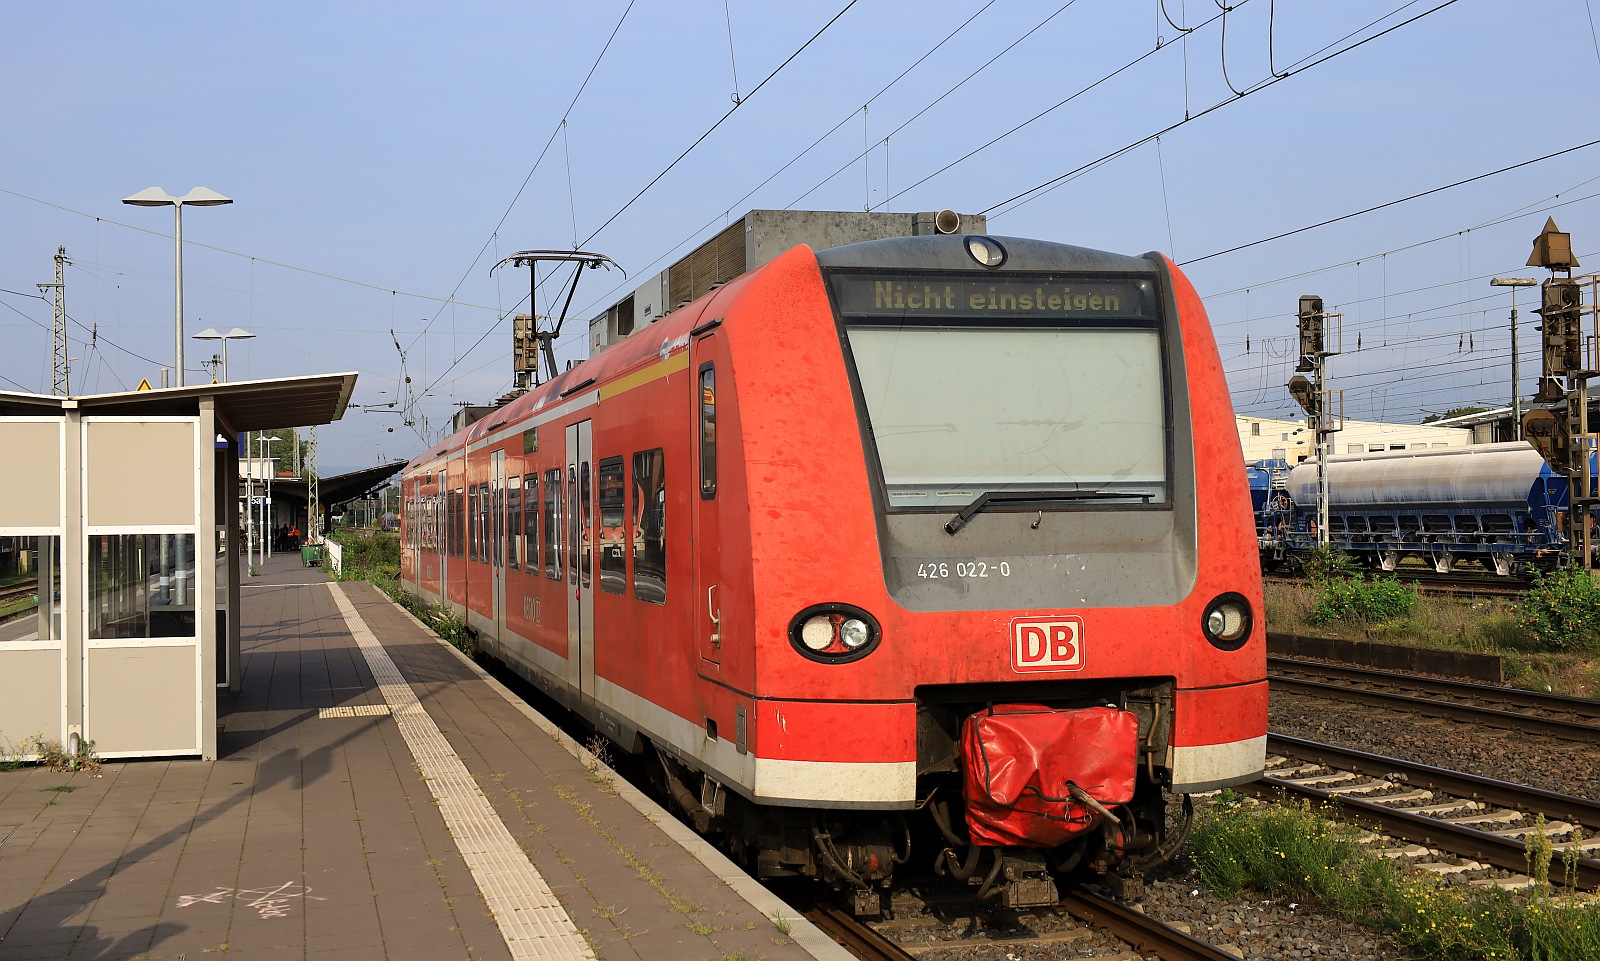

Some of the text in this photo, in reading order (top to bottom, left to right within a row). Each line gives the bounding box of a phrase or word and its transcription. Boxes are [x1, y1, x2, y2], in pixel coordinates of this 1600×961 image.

[875, 280, 1120, 311] Nicht einsteigen
[917, 561, 1011, 579] 426 022-0
[1020, 625, 1076, 663] DB
